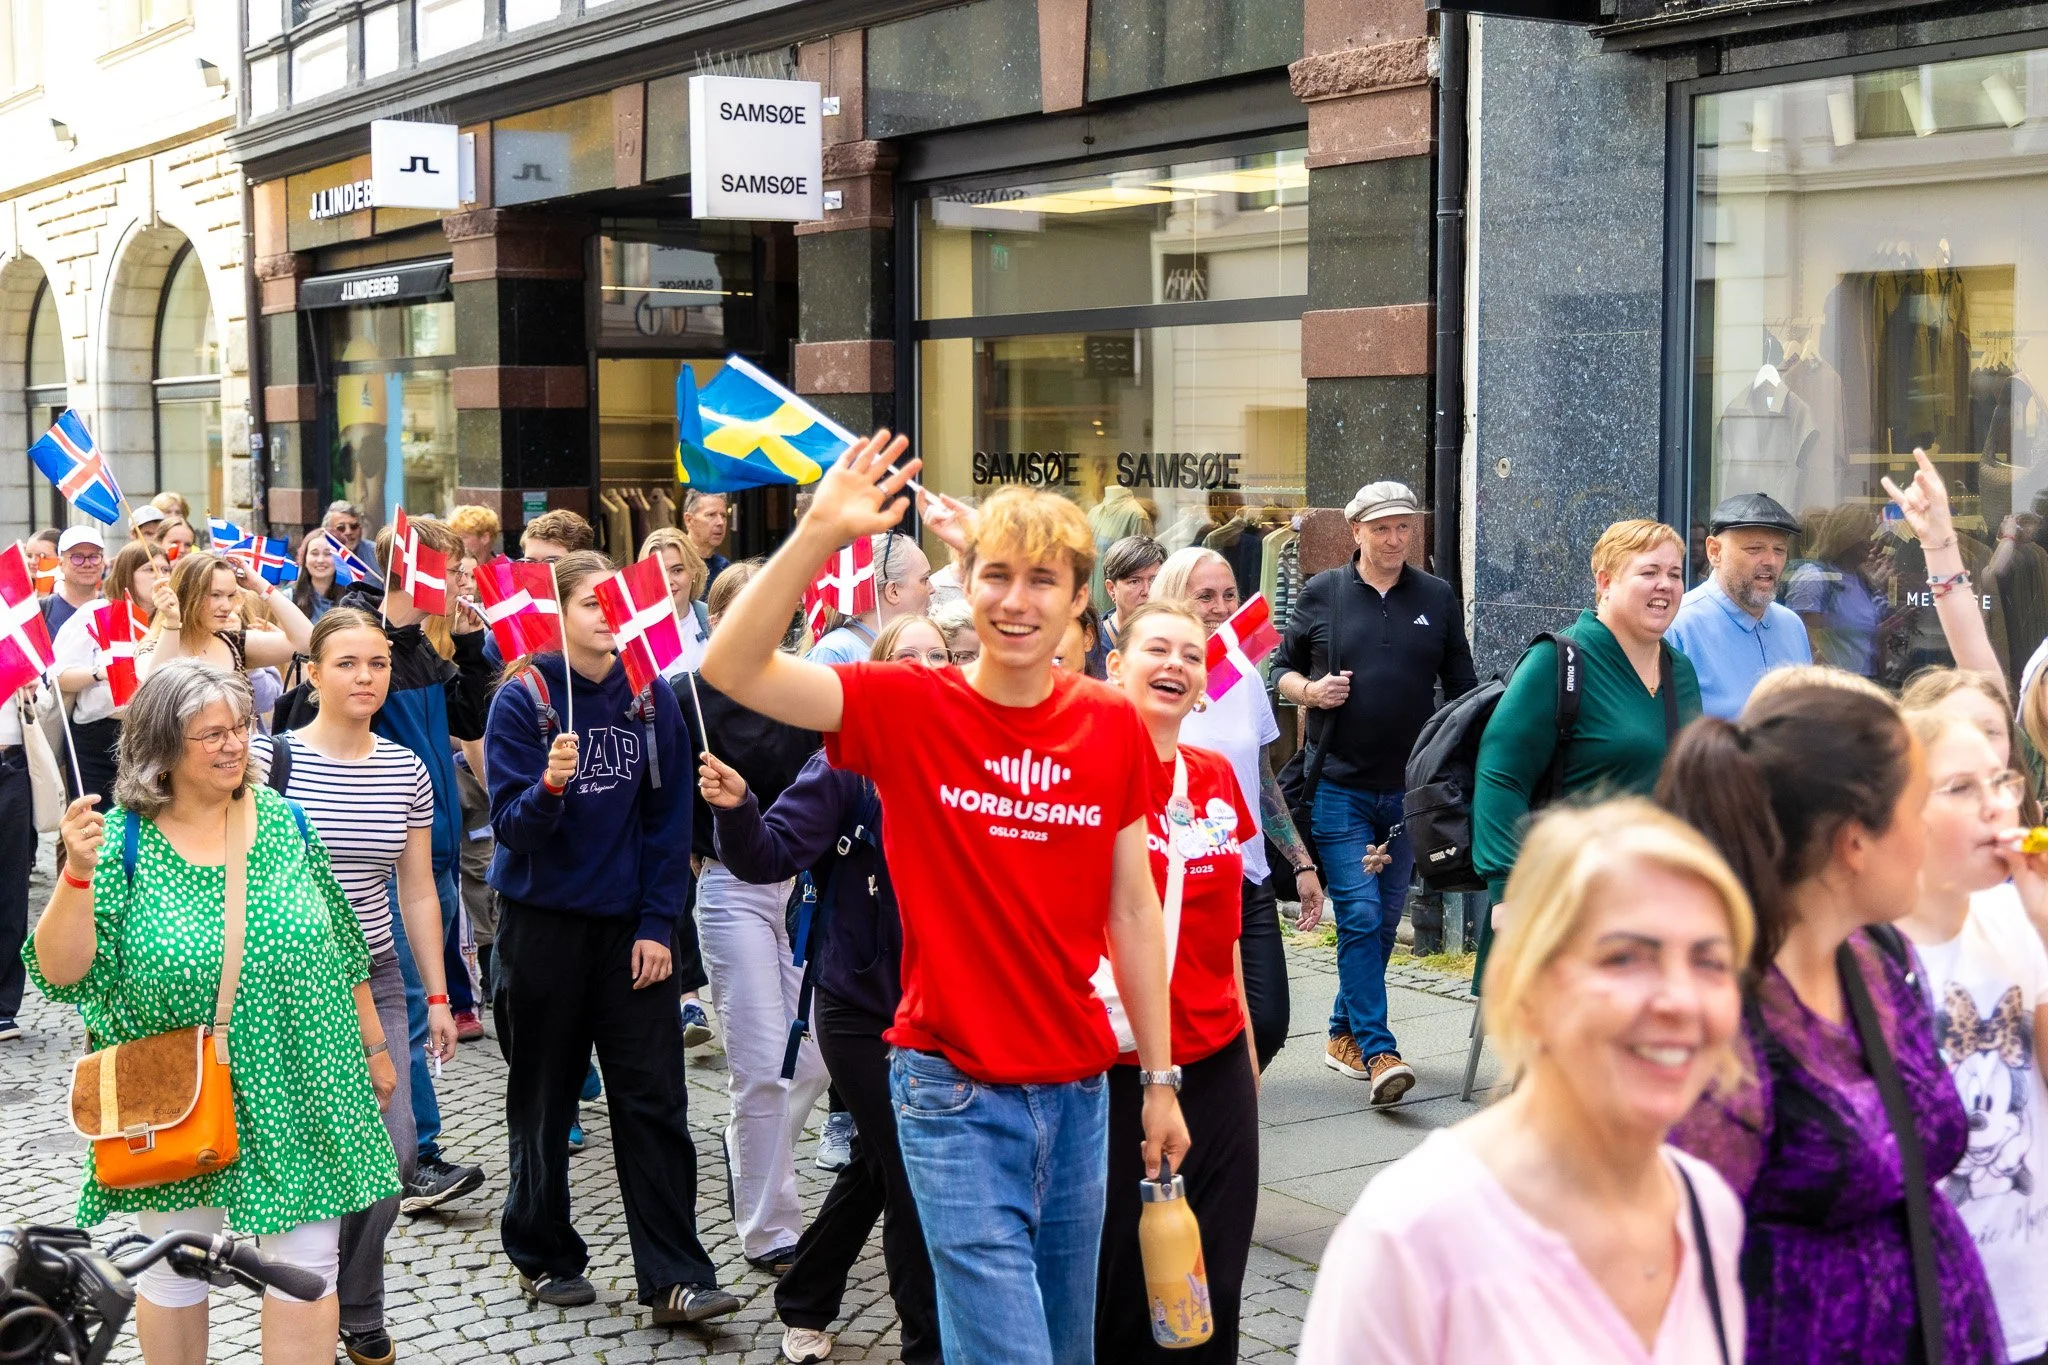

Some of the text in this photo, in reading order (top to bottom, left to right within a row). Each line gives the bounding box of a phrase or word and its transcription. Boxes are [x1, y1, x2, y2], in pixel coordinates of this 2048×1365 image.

[719, 101, 806, 125] SAMSØE
[721, 173, 808, 195] SAMSØE
[308, 178, 374, 221] J.LINDEB
[341, 274, 399, 301] J.LINDEBERG
[972, 451, 1241, 491] SAMSØE SAMSØE
[1566, 665, 1575, 692] arena
[568, 725, 640, 783] AP
[940, 784, 1101, 827] NORBUSANG
[989, 825, 1048, 842] OSLO 2025
[1190, 865, 1214, 875] 2025
